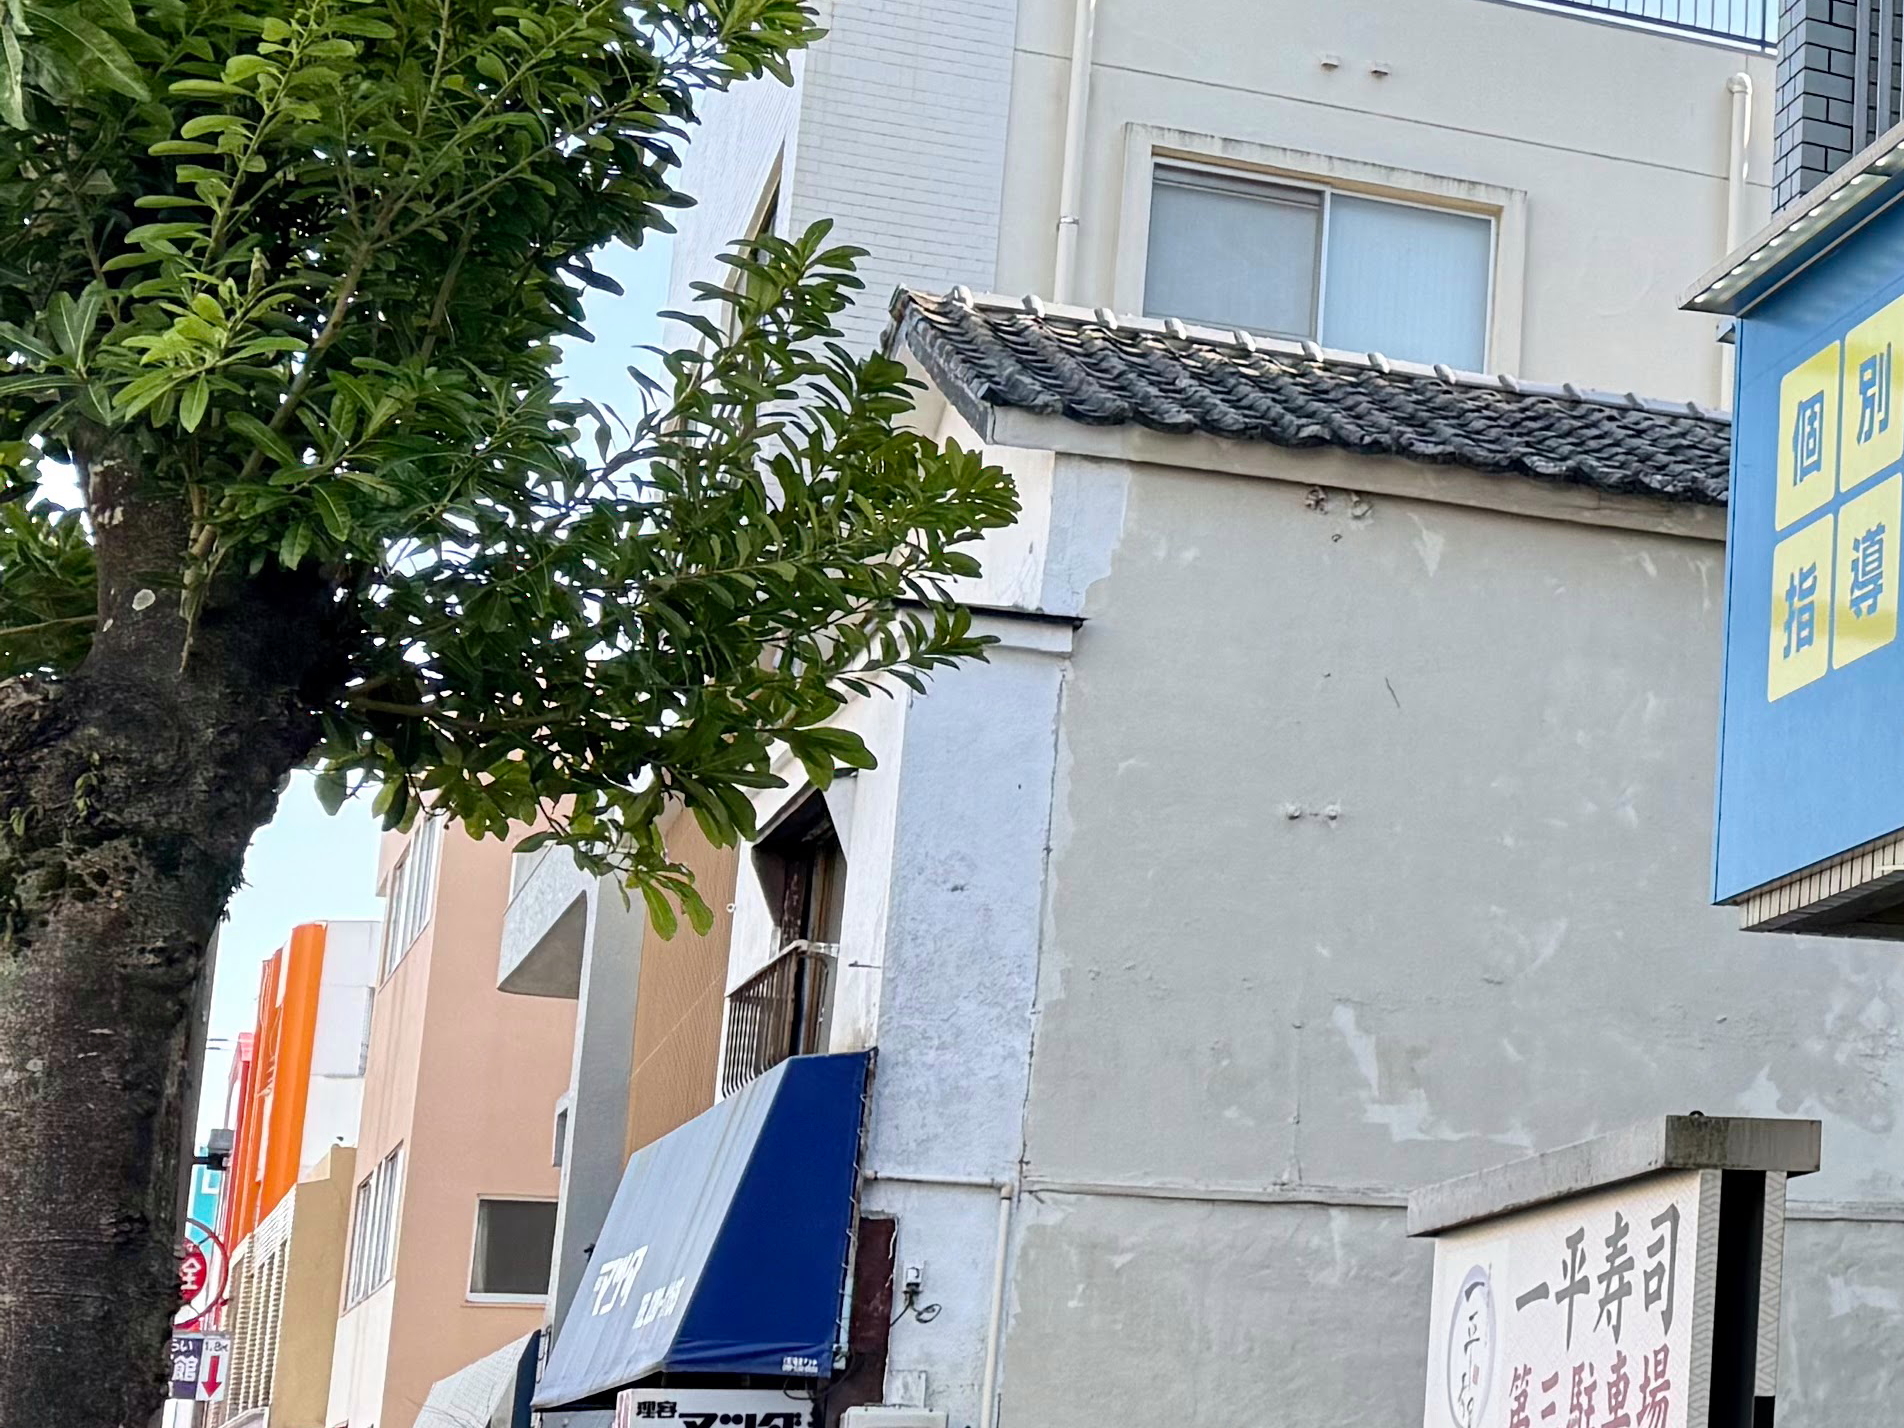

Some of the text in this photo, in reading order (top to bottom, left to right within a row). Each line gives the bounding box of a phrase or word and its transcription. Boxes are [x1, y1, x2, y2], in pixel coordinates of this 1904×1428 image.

[1791, 350, 1893, 491] 個別
[1781, 522, 1887, 663] 指導
[1515, 1203, 1681, 1352] 一平寿司
[636, 1400, 678, 1419] 理容
